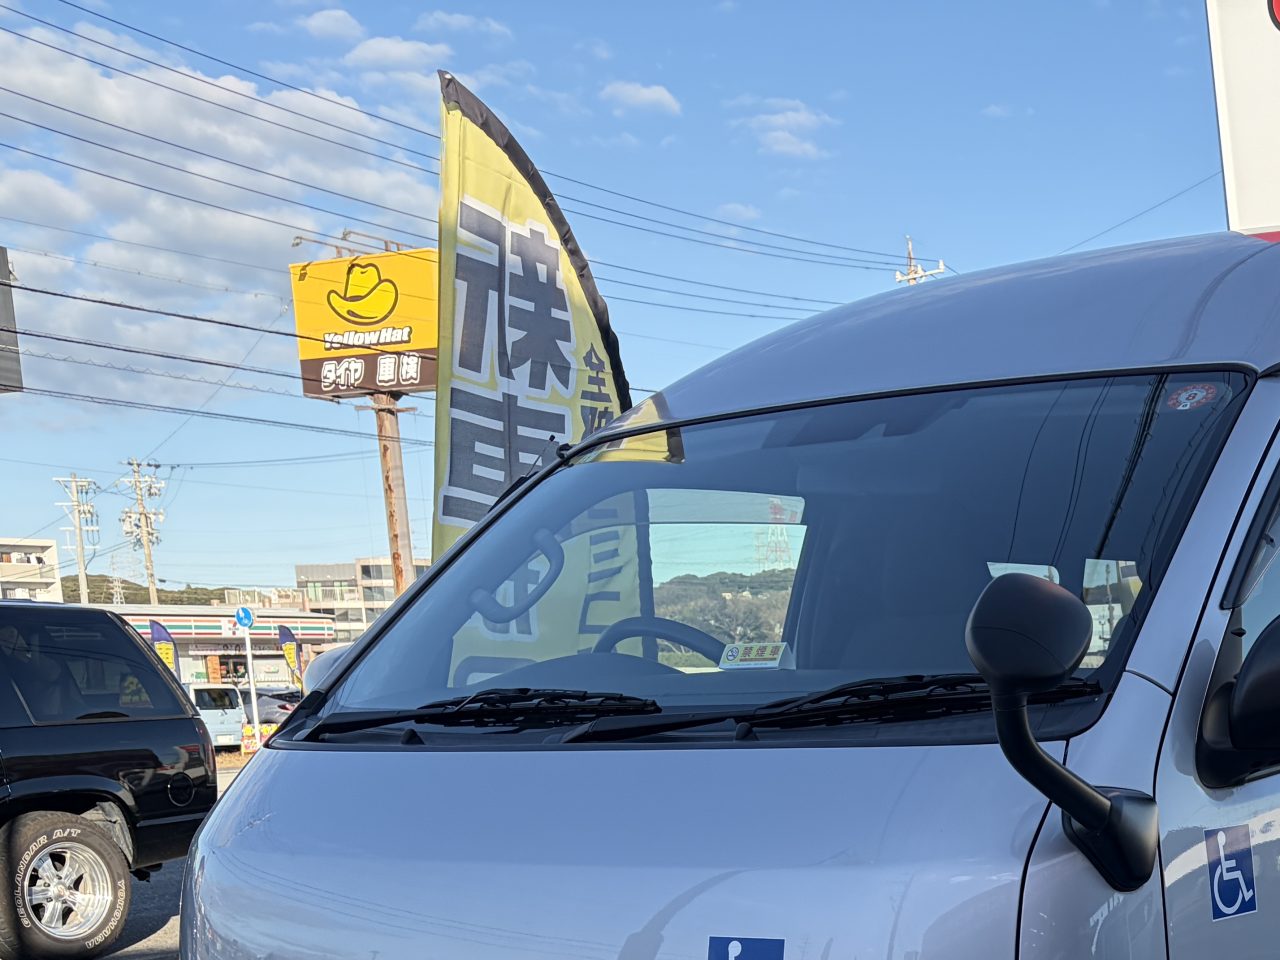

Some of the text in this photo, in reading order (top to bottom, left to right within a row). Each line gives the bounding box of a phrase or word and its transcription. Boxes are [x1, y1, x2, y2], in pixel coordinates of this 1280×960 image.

[321, 357, 365, 391] タイヤ
[15, 828, 81, 928] GEOLANDAR A/T
